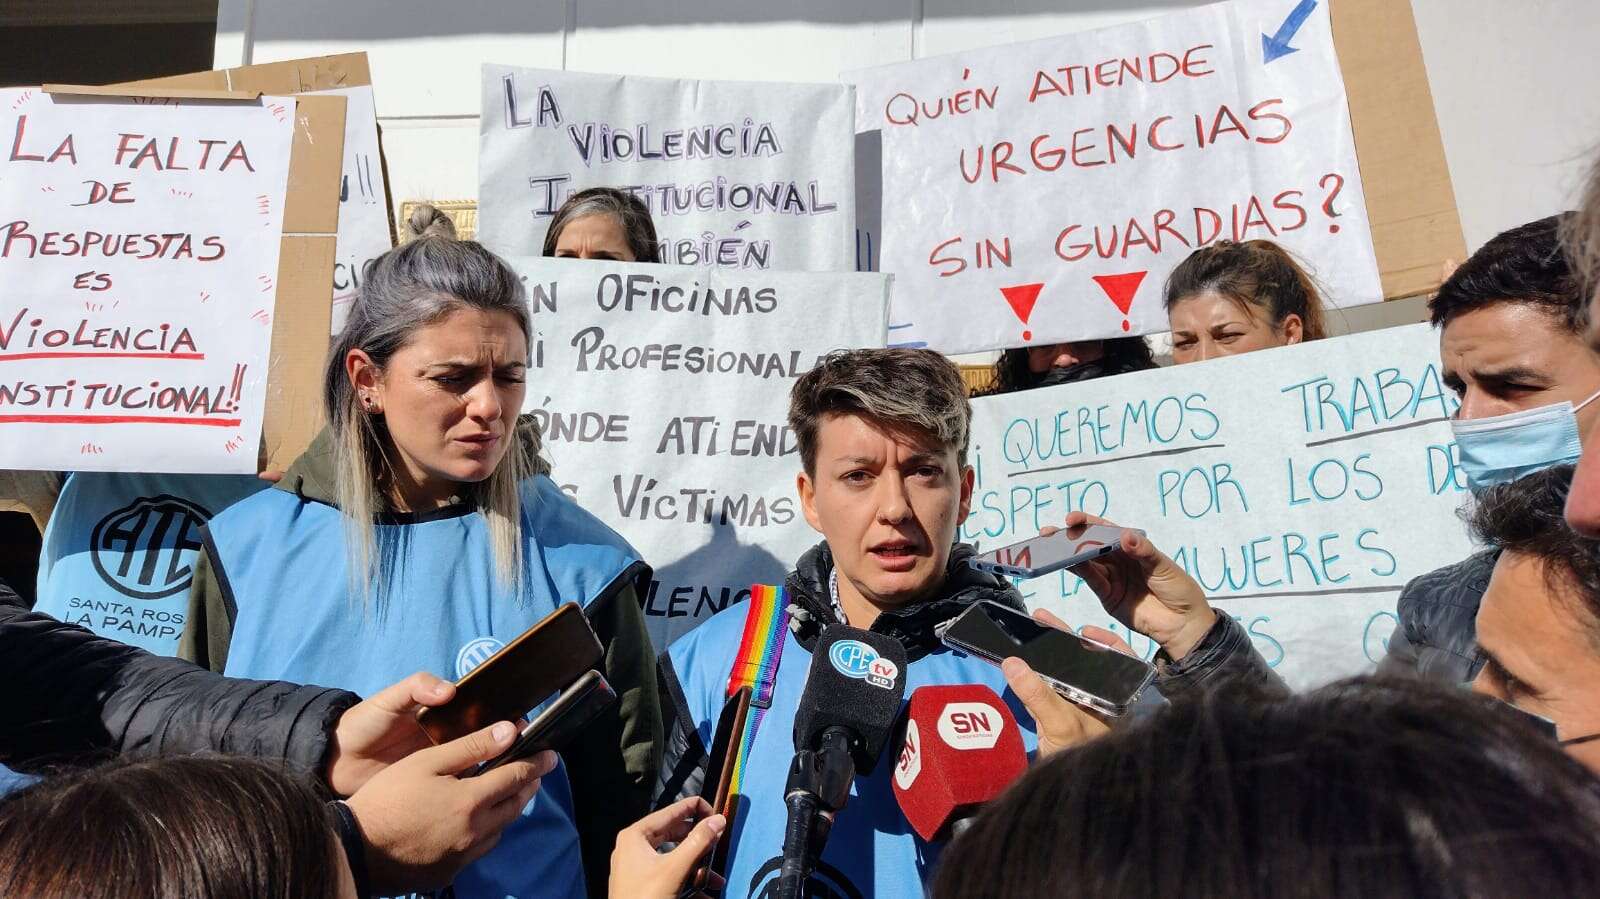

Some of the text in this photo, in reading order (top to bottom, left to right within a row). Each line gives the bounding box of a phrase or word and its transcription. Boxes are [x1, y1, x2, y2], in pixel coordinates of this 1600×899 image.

[503, 74, 563, 129] LA
[886, 45, 1215, 126] QUIÉN ATIENDE
[8, 114, 255, 172] LA FALTA
[960, 99, 1292, 183] URGENCIAS
[70, 180, 136, 207] DE
[0, 220, 225, 262] RESPUESTAS
[929, 237, 1011, 277] SIN
[73, 271, 112, 291] ES
[1003, 393, 1220, 469] QUEREMOS
[1281, 363, 1461, 433] TRABA
[1159, 463, 1249, 519] POR
[1288, 453, 1383, 506] LOS
[65, 611, 93, 627] LA
[69, 597, 186, 625] SANTA ROS
[873, 676, 888, 685] HD
[874, 663, 893, 676] tv
[950, 711, 992, 734] SN
